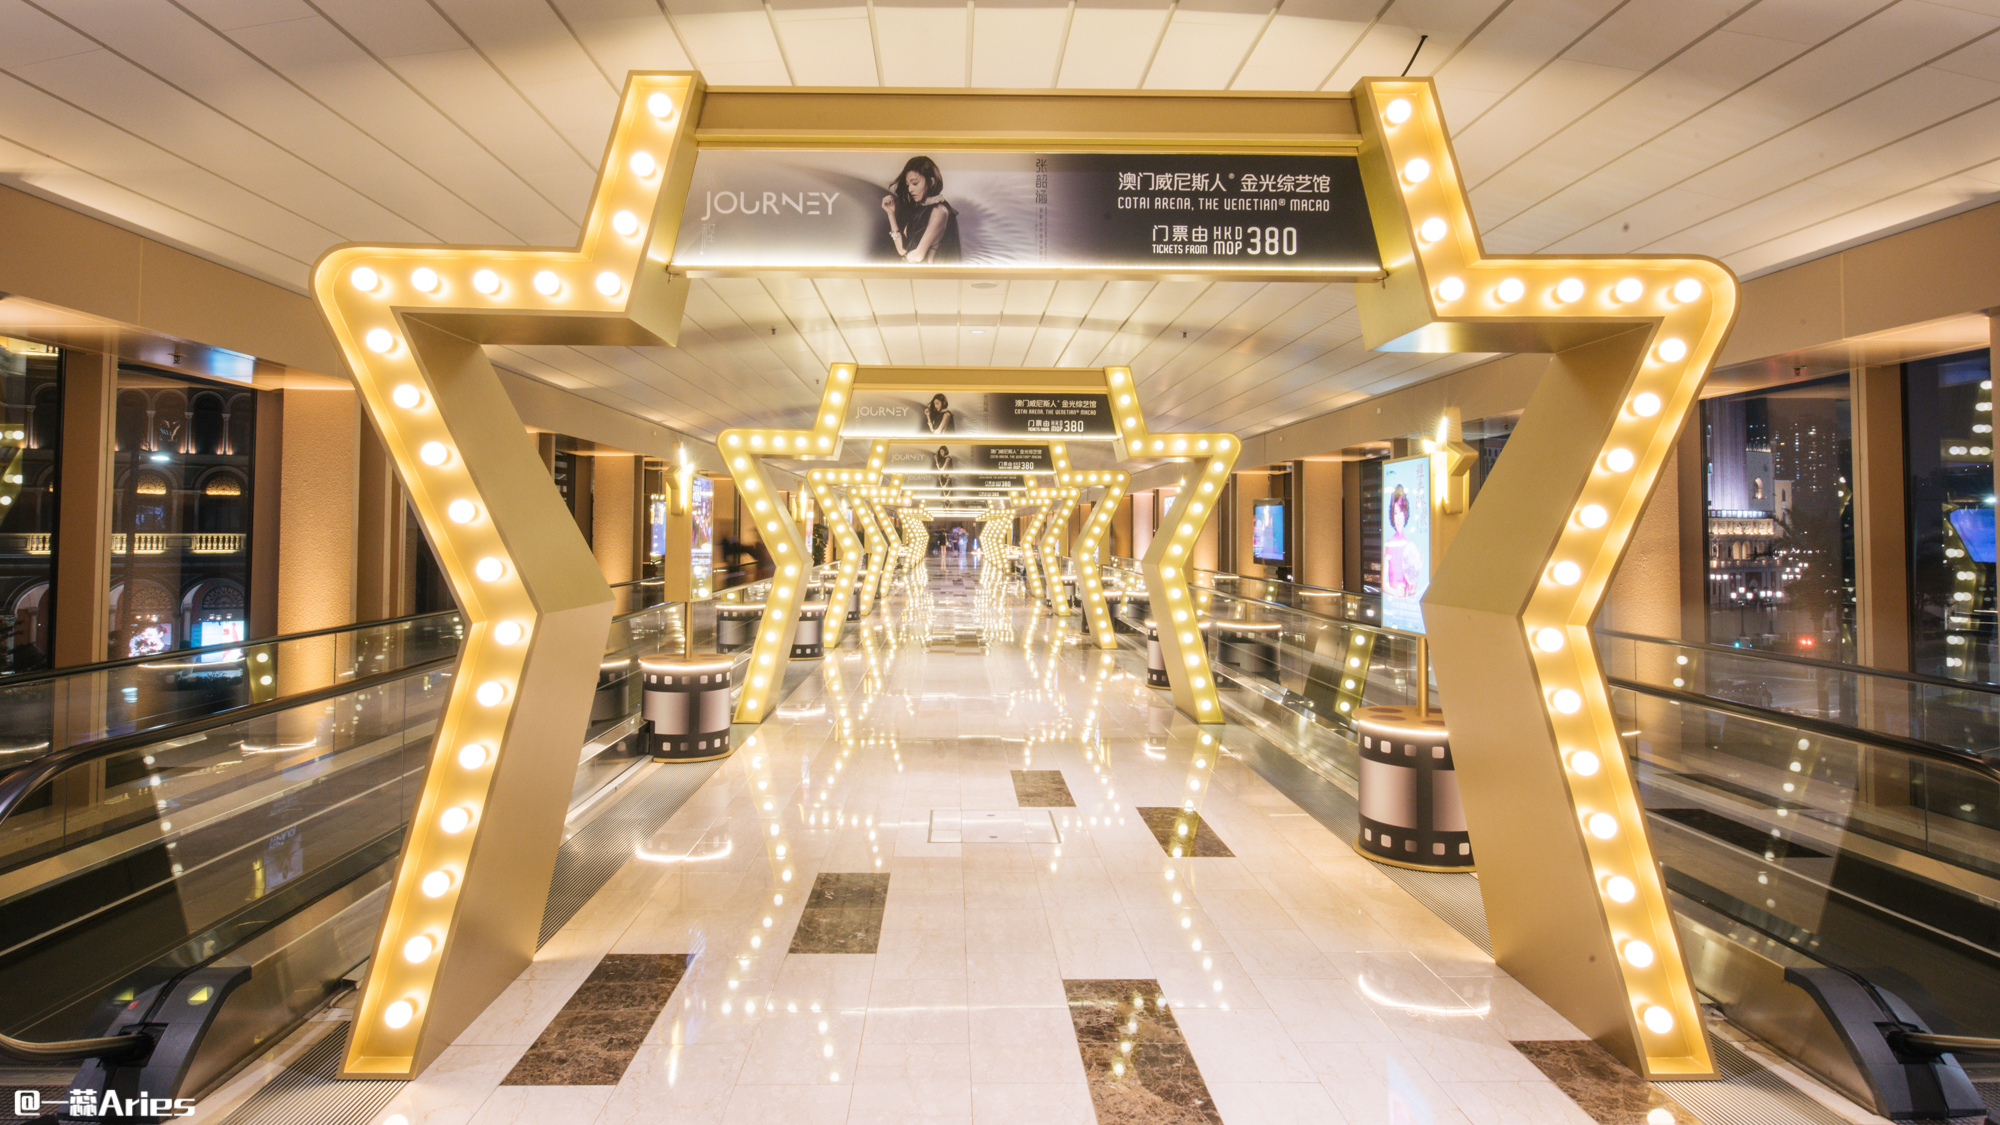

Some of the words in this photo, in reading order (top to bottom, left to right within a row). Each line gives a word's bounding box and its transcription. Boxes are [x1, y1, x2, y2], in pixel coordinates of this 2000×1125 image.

[1035, 158, 1048, 204] 张韶涵
[1240, 173, 1331, 193] 金光综艺馆
[700, 191, 840, 221] JOURNEY
[1117, 196, 1150, 209] COTAI
[1154, 197, 1194, 211] ARENA,
[1198, 197, 1219, 210] THE
[1290, 199, 1330, 212] MACAO
[1152, 225, 1208, 242] 门票由
[1213, 226, 1243, 240] HKD
[1246, 226, 1297, 255] 380
[1152, 244, 1183, 254] TICKETS
[1185, 245, 1208, 254] FROM
[1213, 241, 1243, 255] MOP
[855, 406, 909, 419] JOURNEY
[1064, 420, 1084, 432] 380
[891, 454, 925, 462] JOURNEY
[1021, 461, 1034, 469] 380
